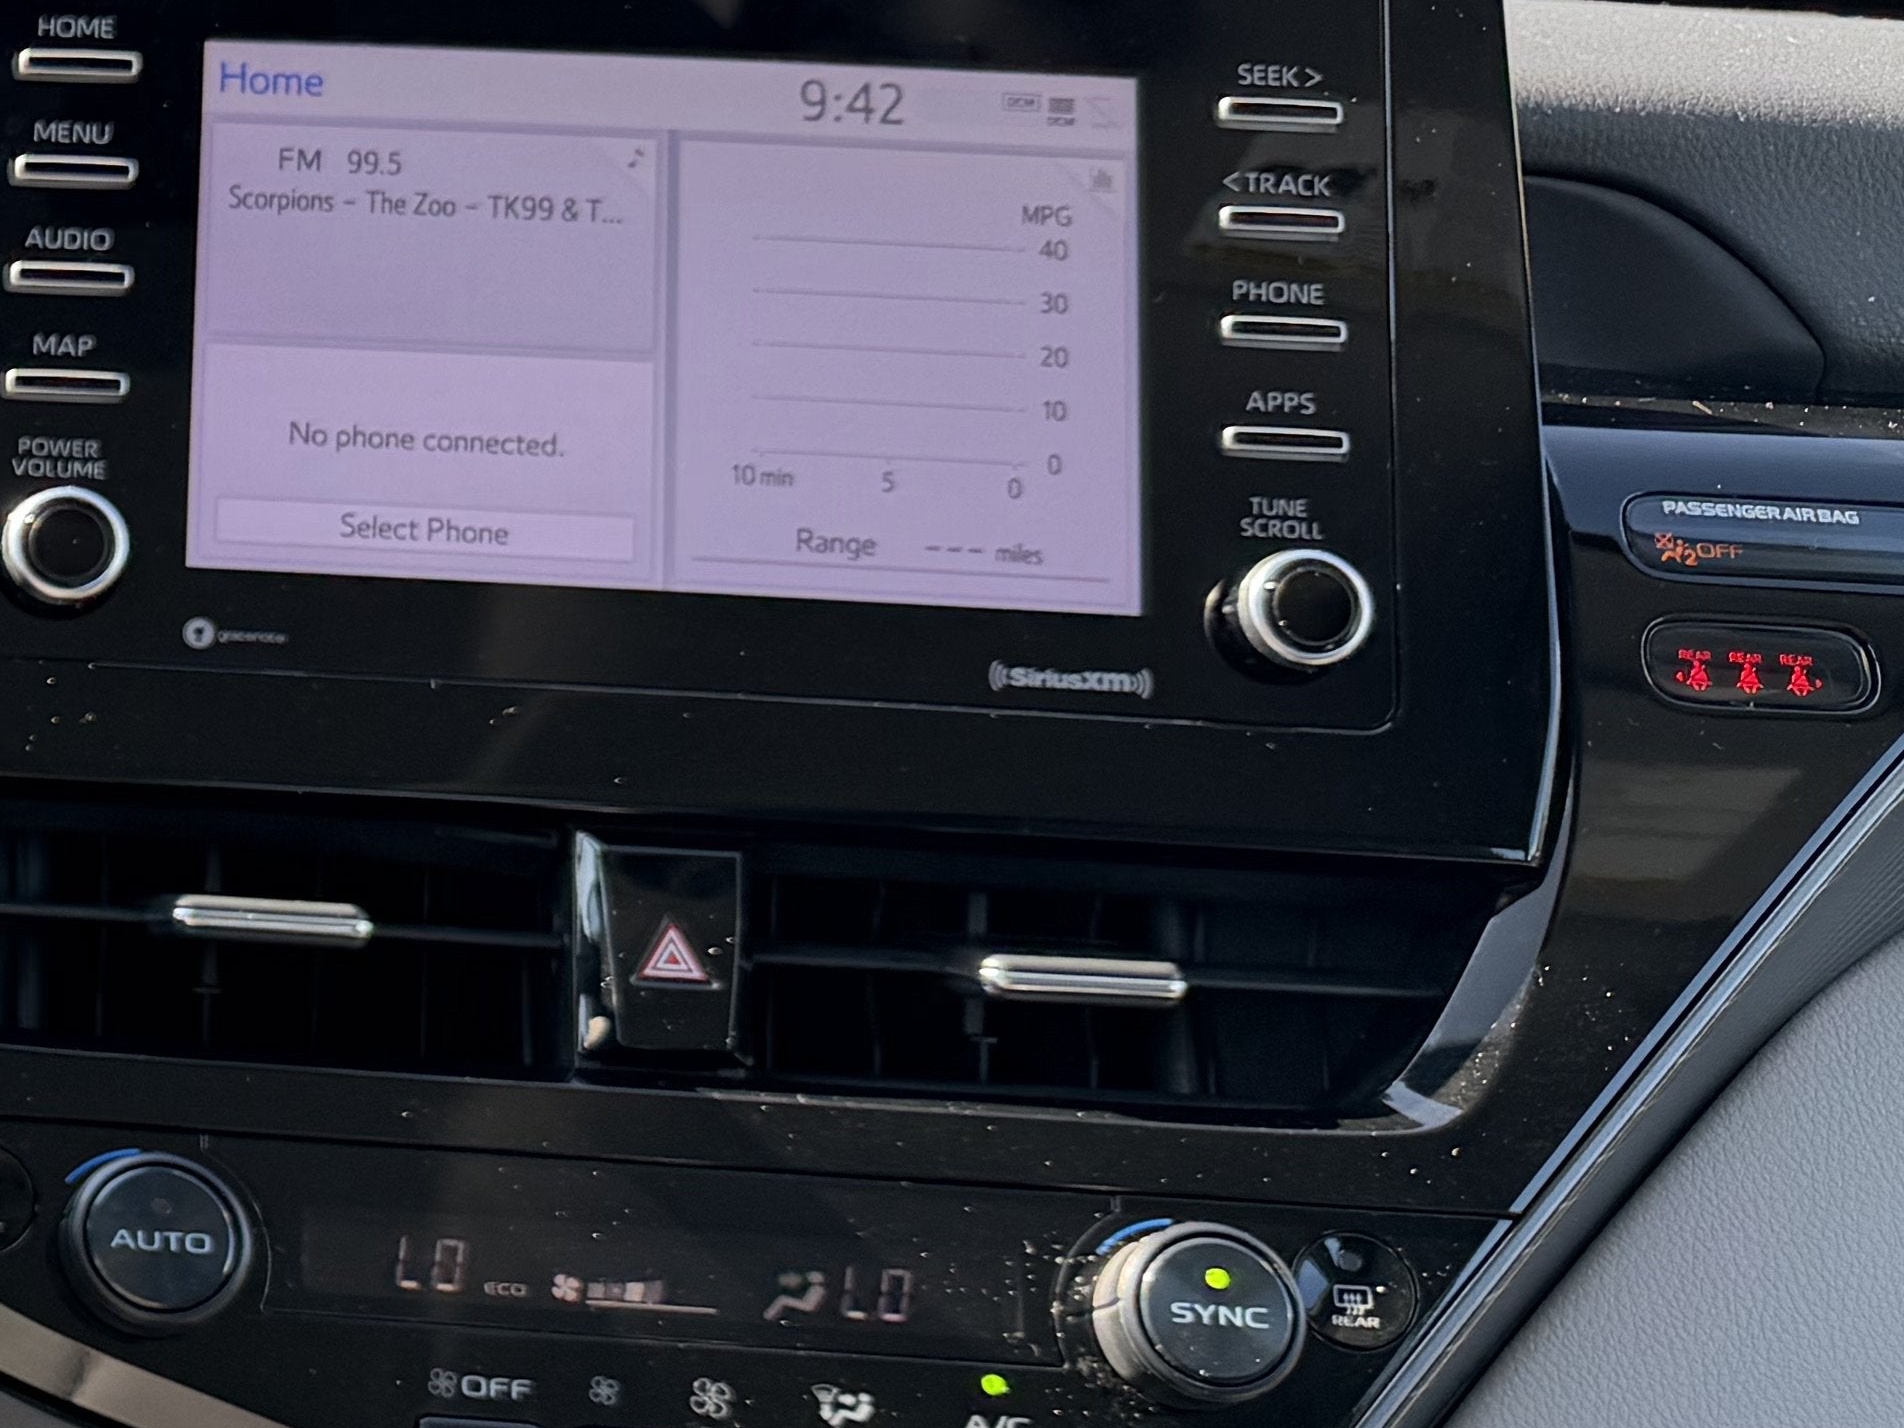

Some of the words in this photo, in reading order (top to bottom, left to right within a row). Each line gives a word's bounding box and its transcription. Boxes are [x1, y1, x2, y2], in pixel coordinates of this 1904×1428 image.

[37, 15, 117, 40] HOME
[219, 62, 325, 98] Home
[800, 80, 904, 126] 9:42
[33, 122, 113, 146] MENU
[278, 147, 322, 172] FM
[347, 151, 403, 176] 99.5
[228, 184, 334, 216] Scorpions
[366, 190, 407, 217] The
[413, 193, 457, 218] Zoo
[489, 195, 555, 222] TK99
[561, 199, 580, 222] &
[1021, 204, 1073, 228] MPG
[25, 228, 112, 252] AUDIO
[1038, 239, 1069, 261] 40
[1232, 280, 1325, 304] PHONE
[1039, 293, 1068, 315] 30
[32, 334, 92, 357] MAP
[1039, 346, 1069, 369] 20
[1042, 401, 1067, 422] 10
[1246, 392, 1315, 415] APPS
[18, 439, 99, 460] POWER
[289, 421, 327, 447] No
[336, 424, 415, 453] phone
[423, 433, 564, 458] connected.
[12, 460, 106, 480] VOLUME
[732, 463, 757, 487] 10
[759, 468, 794, 488] min
[1047, 453, 1063, 476] 0
[881, 471, 895, 493] 5
[1007, 477, 1024, 500] 0
[1250, 498, 1307, 518] TUNE
[1662, 500, 1780, 520] PASSENGER
[1782, 507, 1816, 522] AIR
[1817, 509, 1860, 525] BAG
[340, 511, 419, 541] Select
[427, 517, 510, 546] Phone
[1240, 519, 1324, 541] SCROLL
[796, 527, 877, 561] Range
[995, 543, 1044, 565] miles
[1696, 543, 1743, 559] OFF
[1729, 651, 1762, 664] REAR
[1779, 653, 1813, 666] REAR
[110, 1228, 216, 1255] AUTO
[484, 1281, 528, 1297] ECO
[1170, 1302, 1269, 1330] SYNC
[1332, 1314, 1380, 1329] REAR
[461, 1375, 532, 1400] OFF
